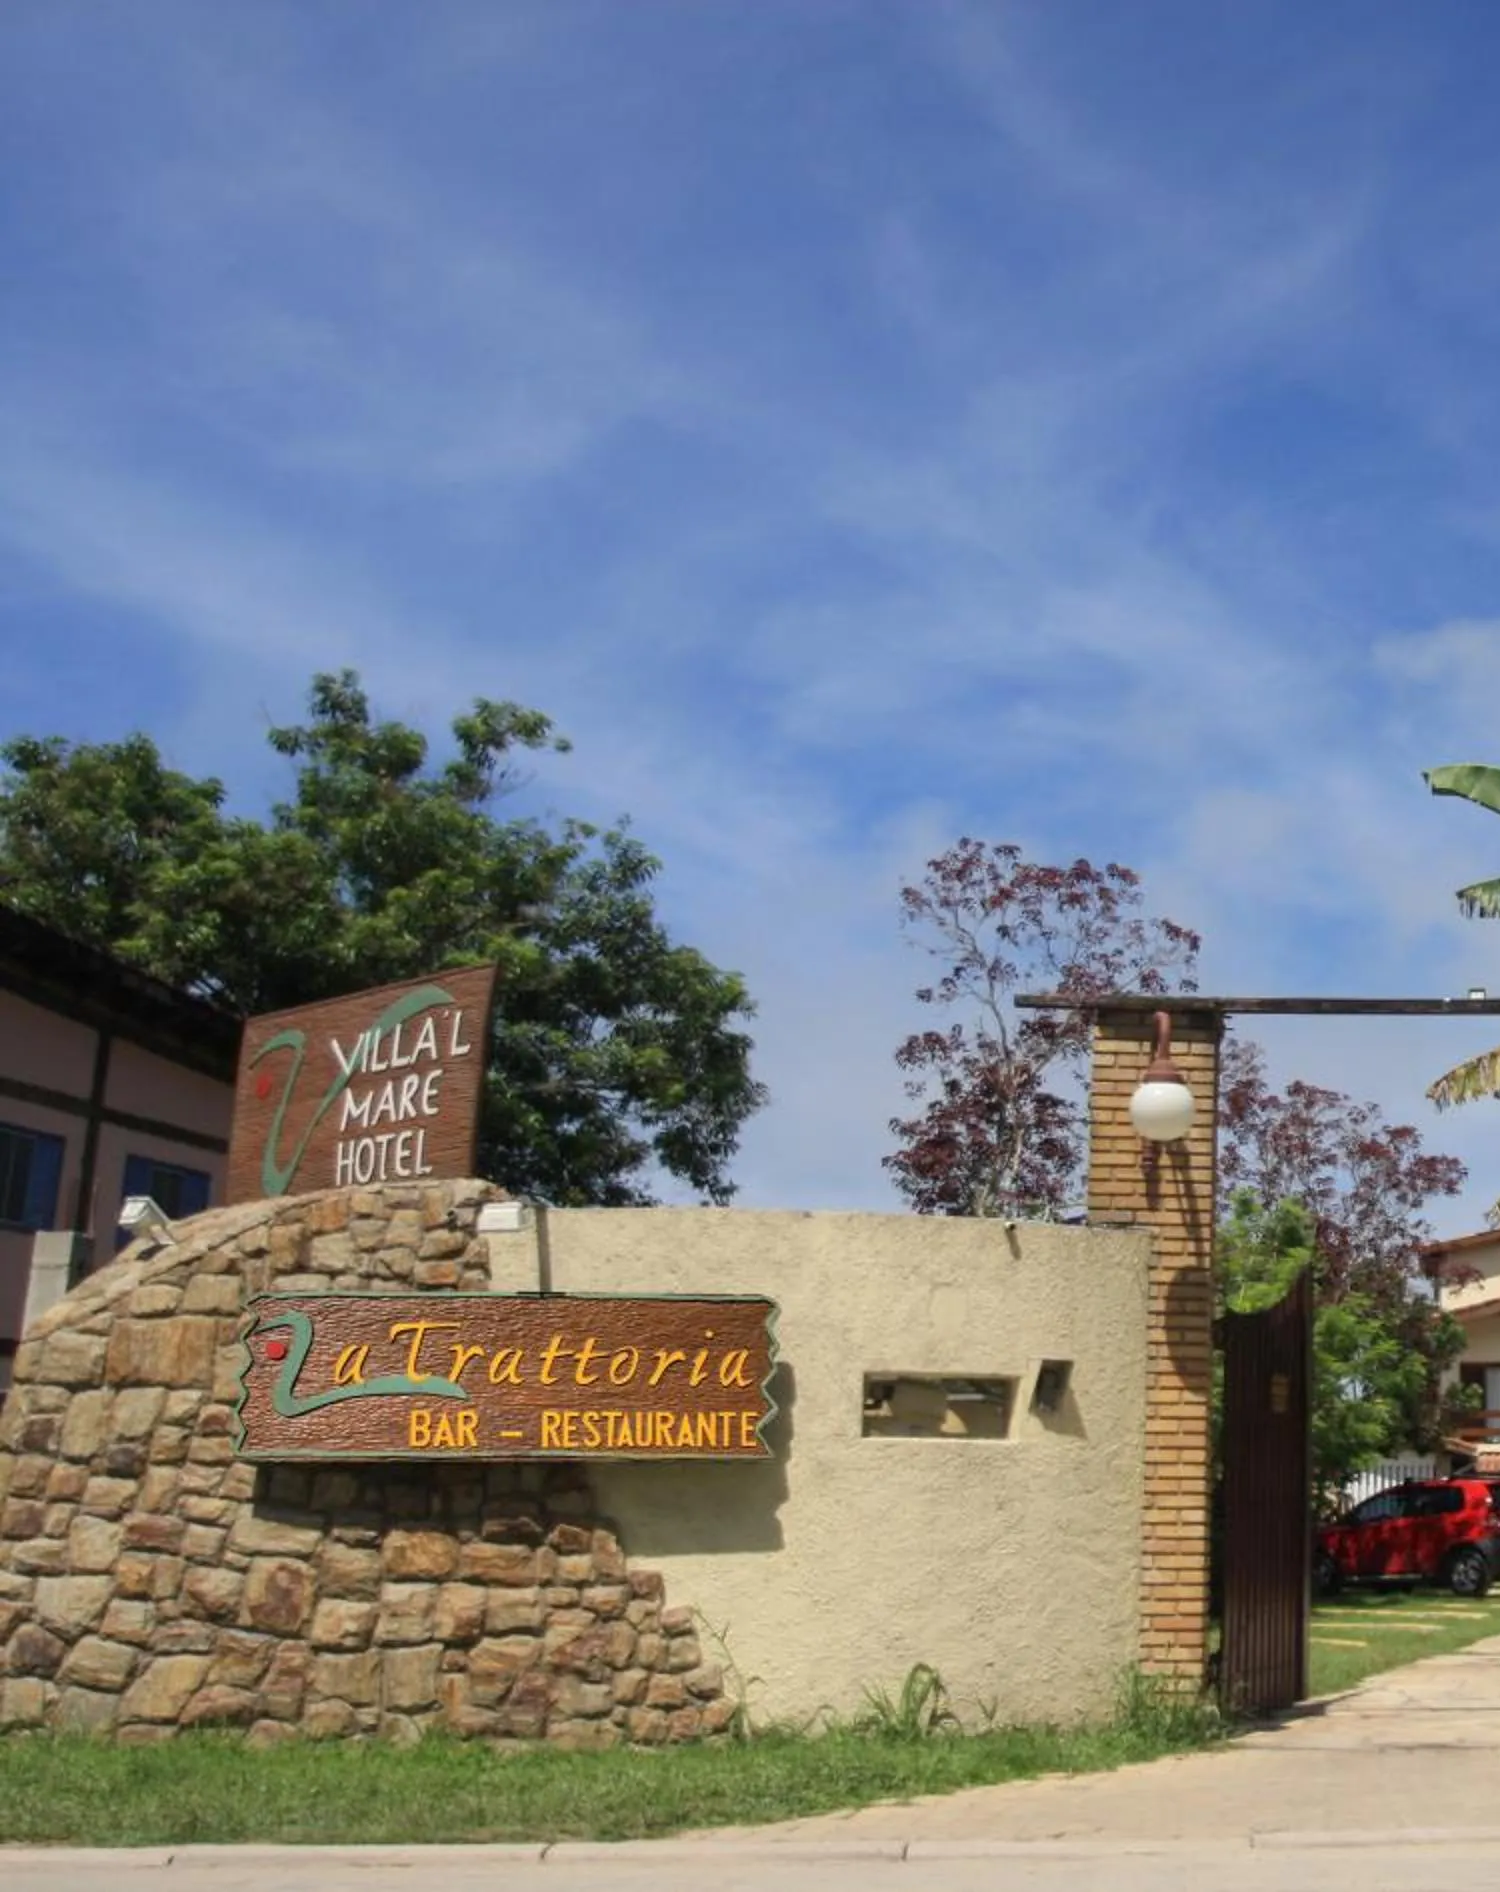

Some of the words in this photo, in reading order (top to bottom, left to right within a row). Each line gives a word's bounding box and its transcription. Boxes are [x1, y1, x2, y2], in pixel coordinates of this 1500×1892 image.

[331, 1010, 471, 1075] VILLA'L
[340, 1069, 443, 1132] MARE
[335, 1129, 432, 1186] HOTEL
[389, 1320, 754, 1387] Trattoria
[407, 1410, 479, 1448] BAR
[541, 1410, 758, 1449] RESTAURANTE
